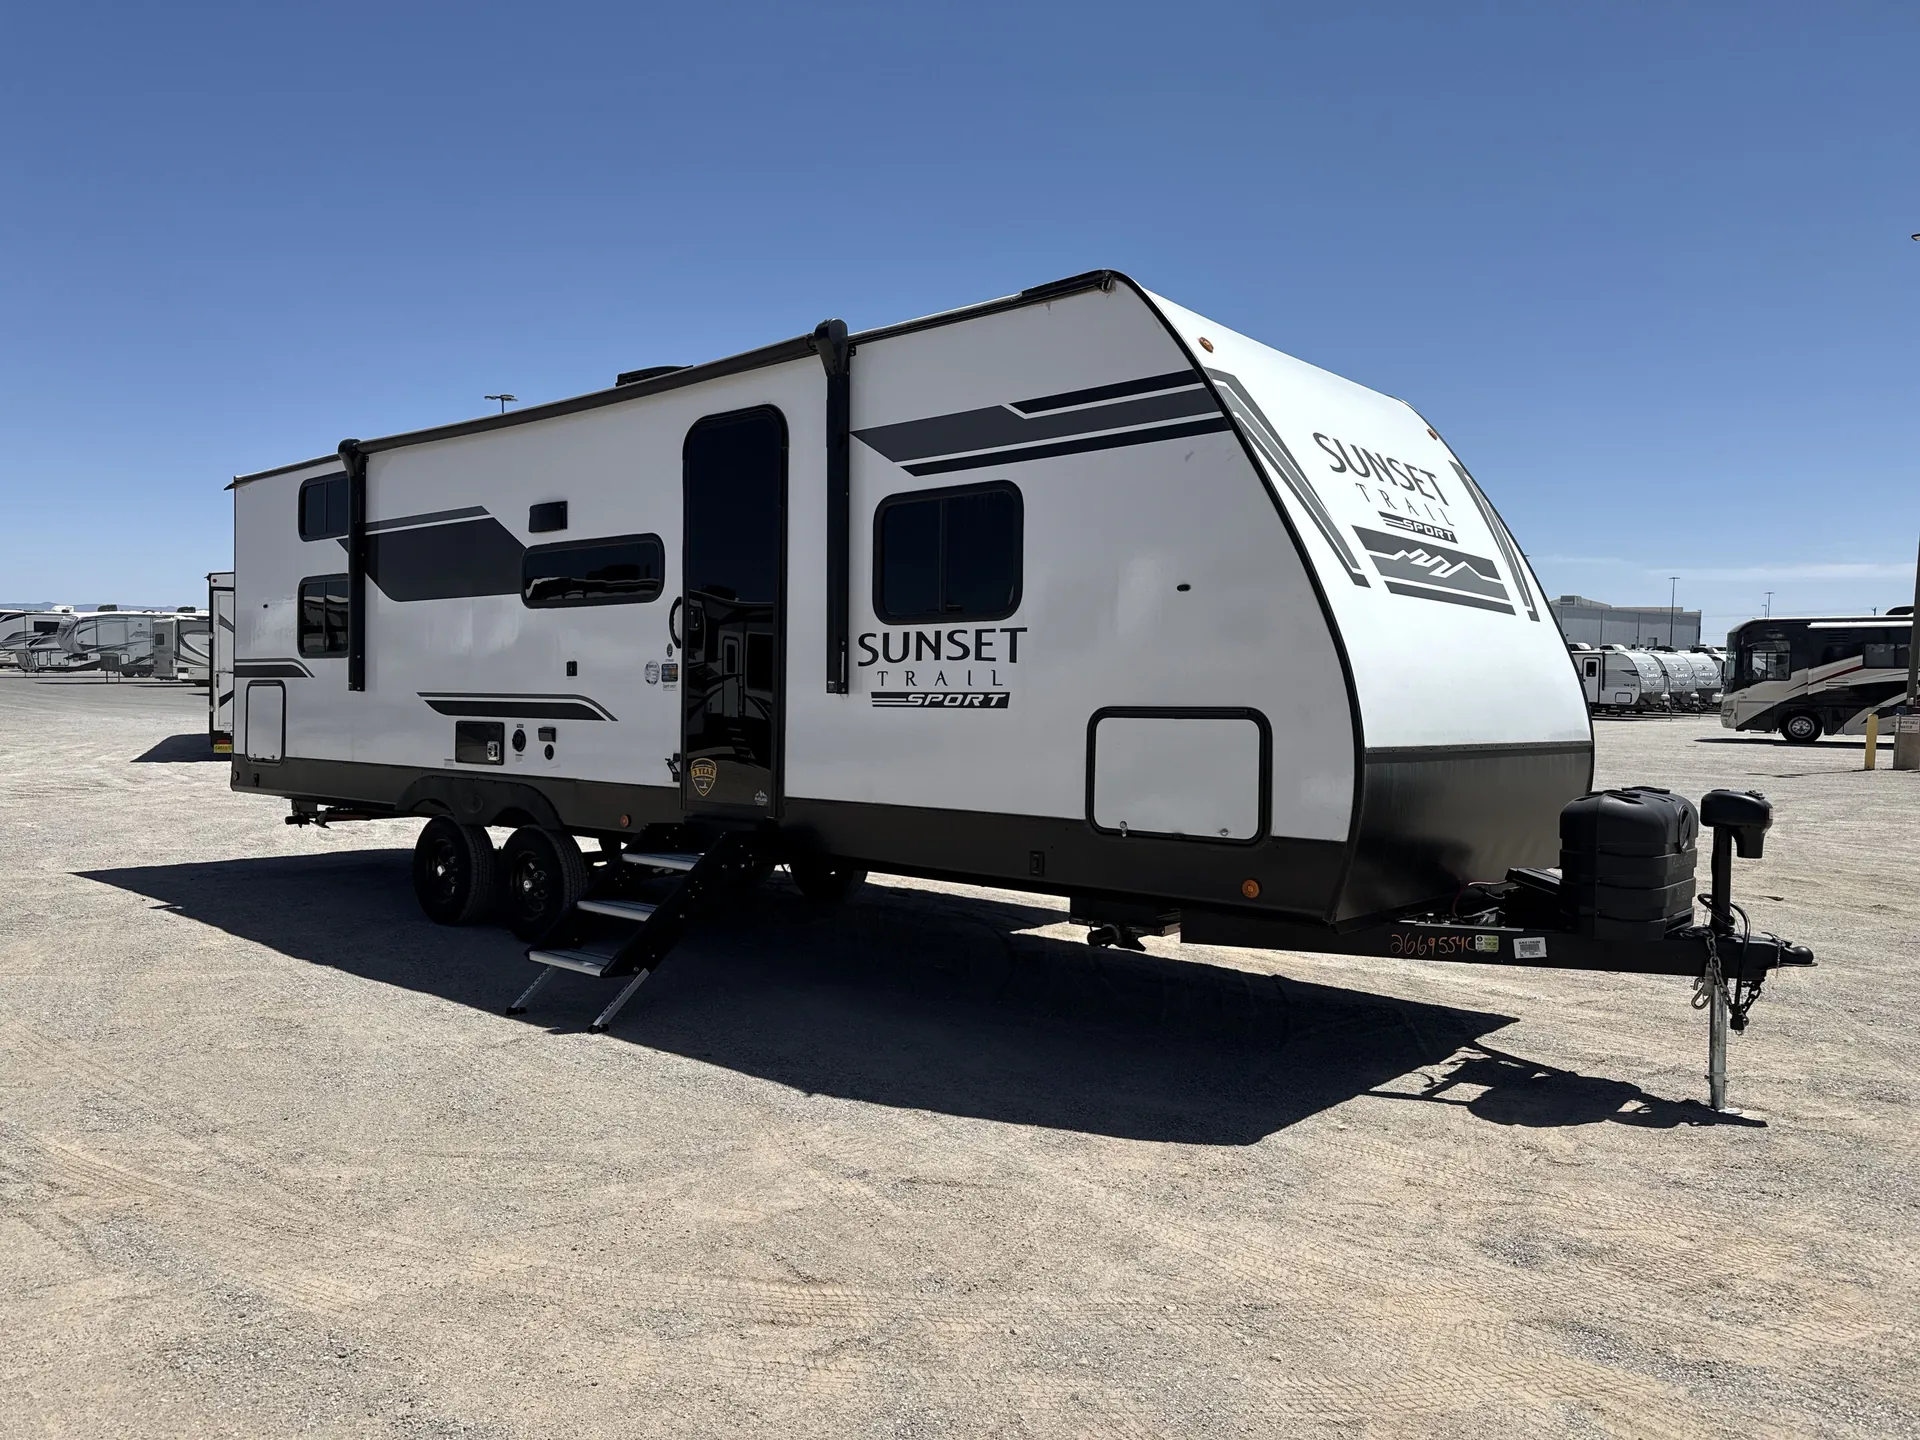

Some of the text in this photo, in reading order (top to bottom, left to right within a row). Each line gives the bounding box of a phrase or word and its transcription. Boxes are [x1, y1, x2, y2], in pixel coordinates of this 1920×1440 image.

[1312, 432, 1450, 507] SUNSET
[1355, 482, 1455, 527] TRAIL
[1402, 519, 1453, 540] SPORT
[858, 627, 1028, 667] SUNSET
[877, 669, 1004, 687] TRAIL
[907, 693, 1007, 707] SPORT
